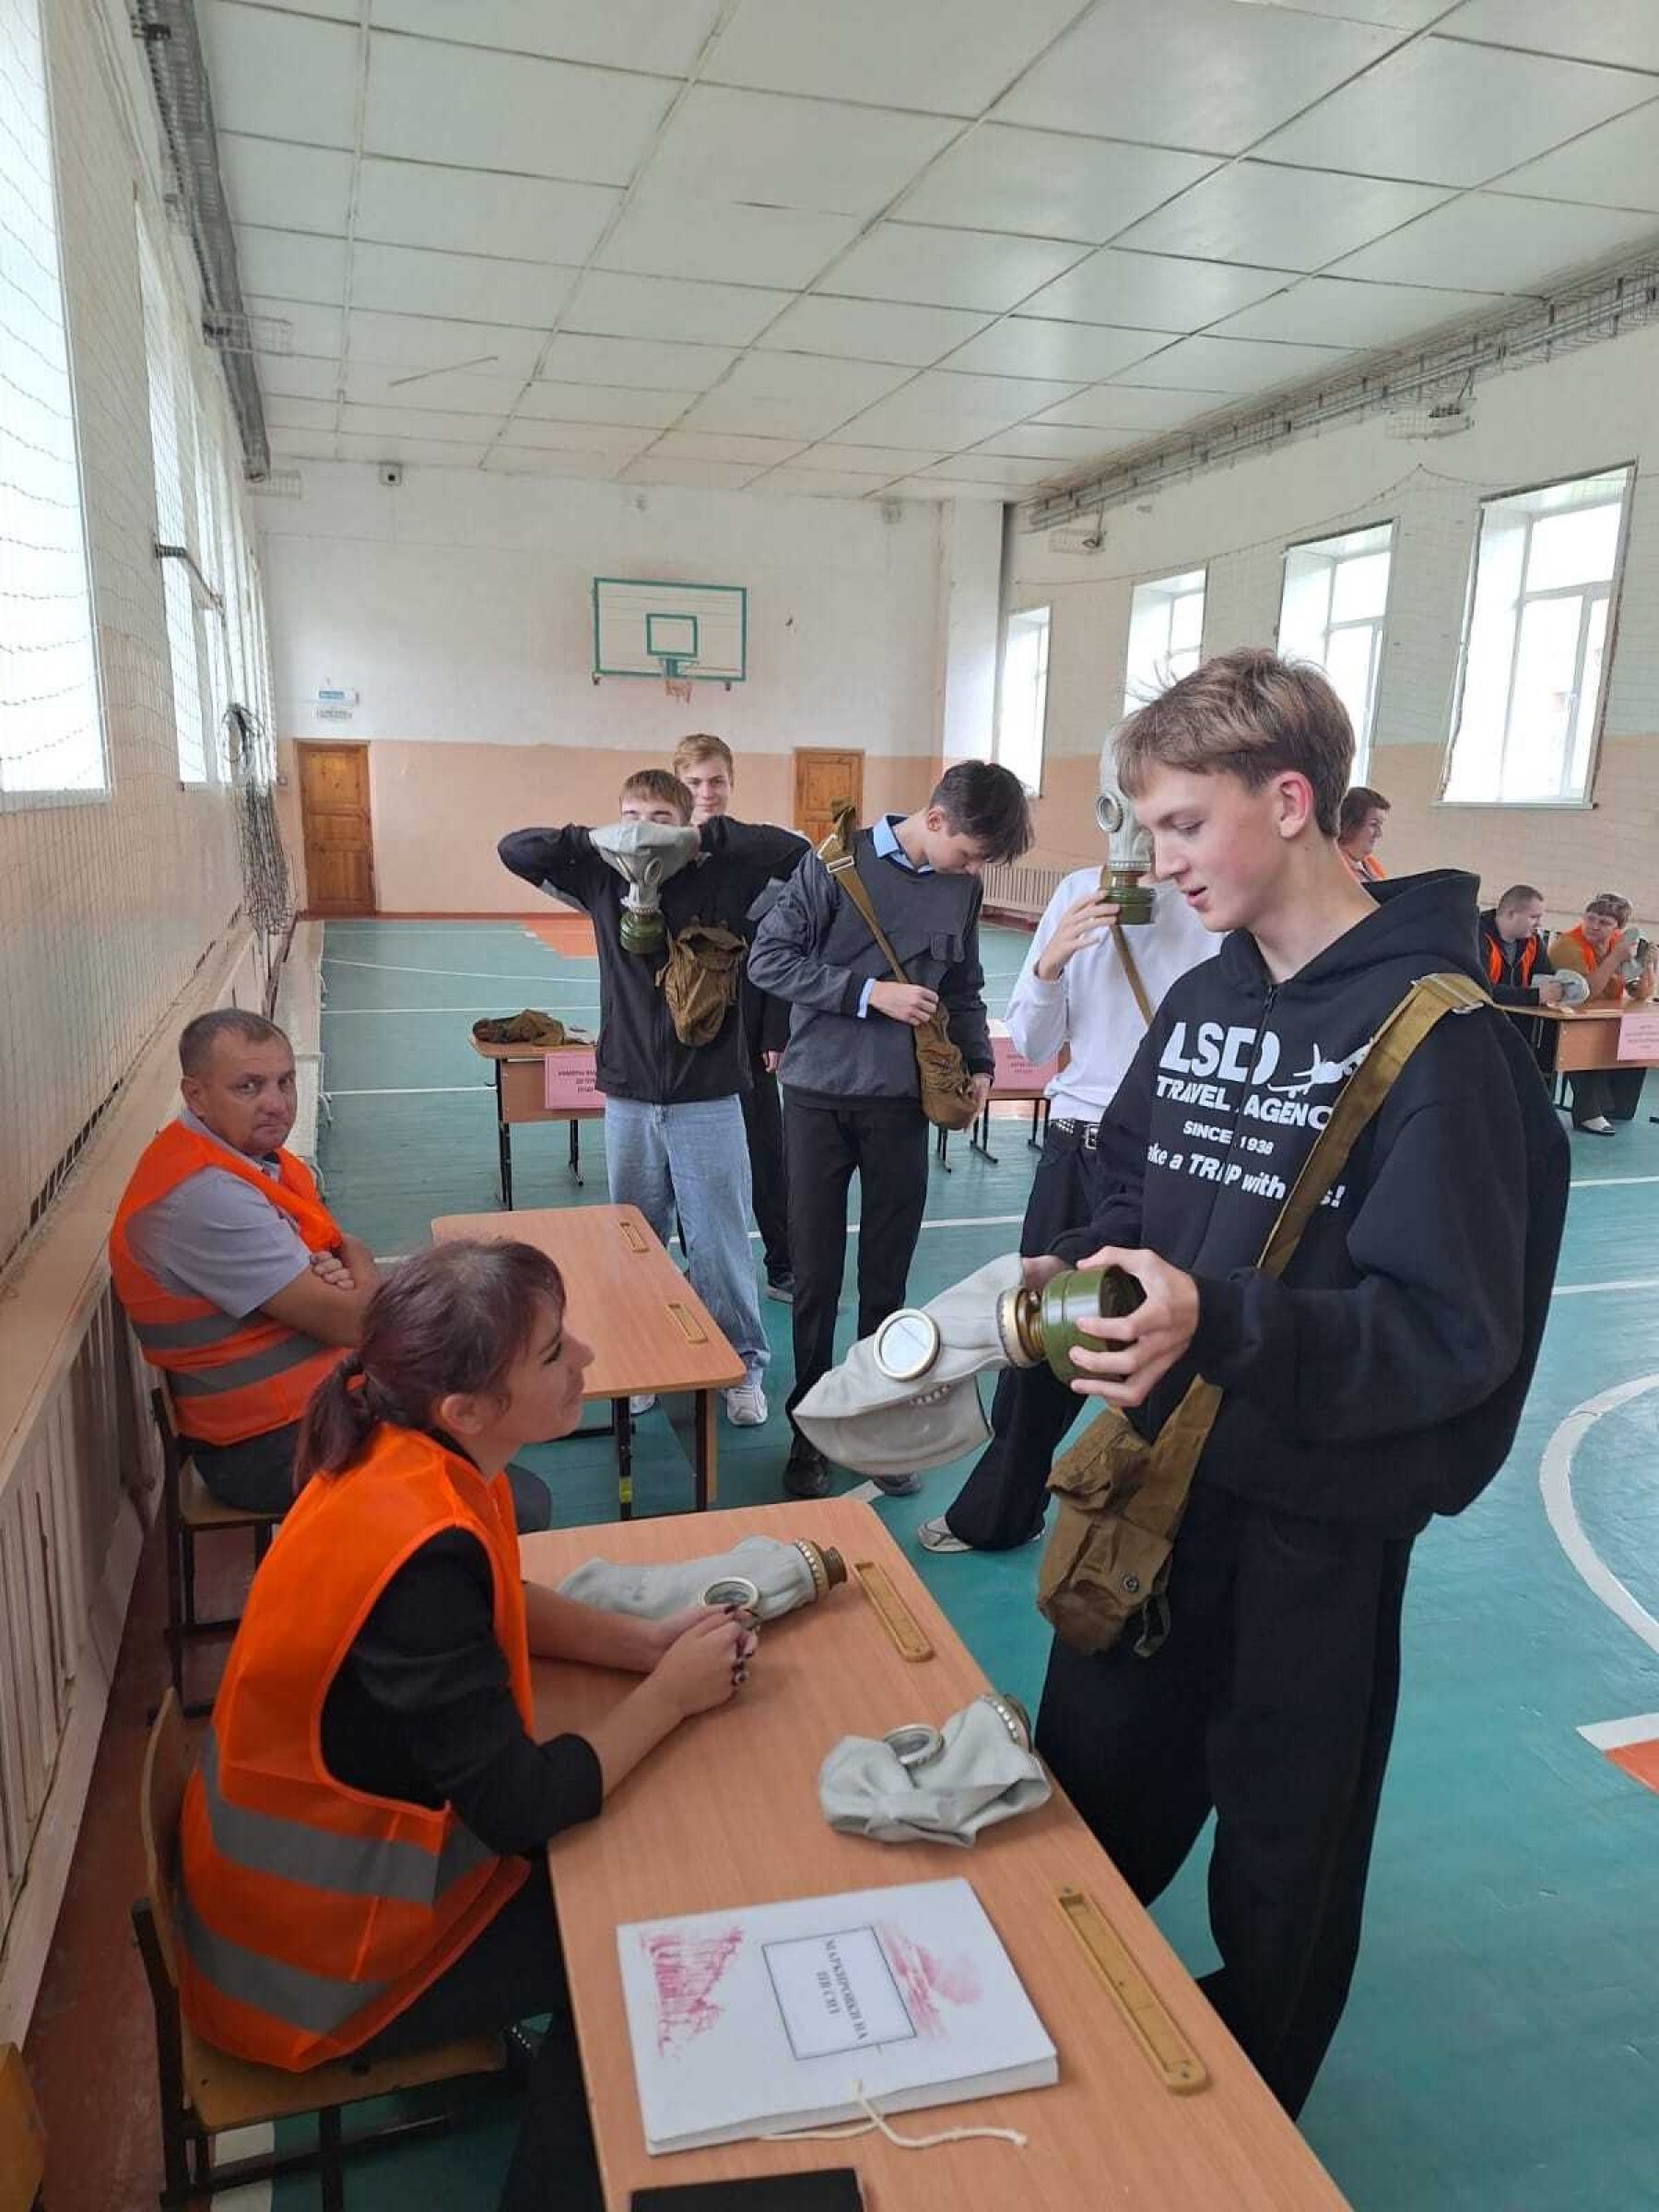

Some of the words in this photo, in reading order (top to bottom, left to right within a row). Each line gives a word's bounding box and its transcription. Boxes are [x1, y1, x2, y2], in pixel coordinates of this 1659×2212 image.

[1156, 1075, 1231, 1112] TRAVEL
[1243, 1094, 1334, 1130] AGENC
[1182, 1119, 1234, 1145] SINCE
[1169, 1154, 1183, 1171] a
[1189, 1153, 1242, 1185] TRIP
[1241, 1171, 1287, 1200] with
